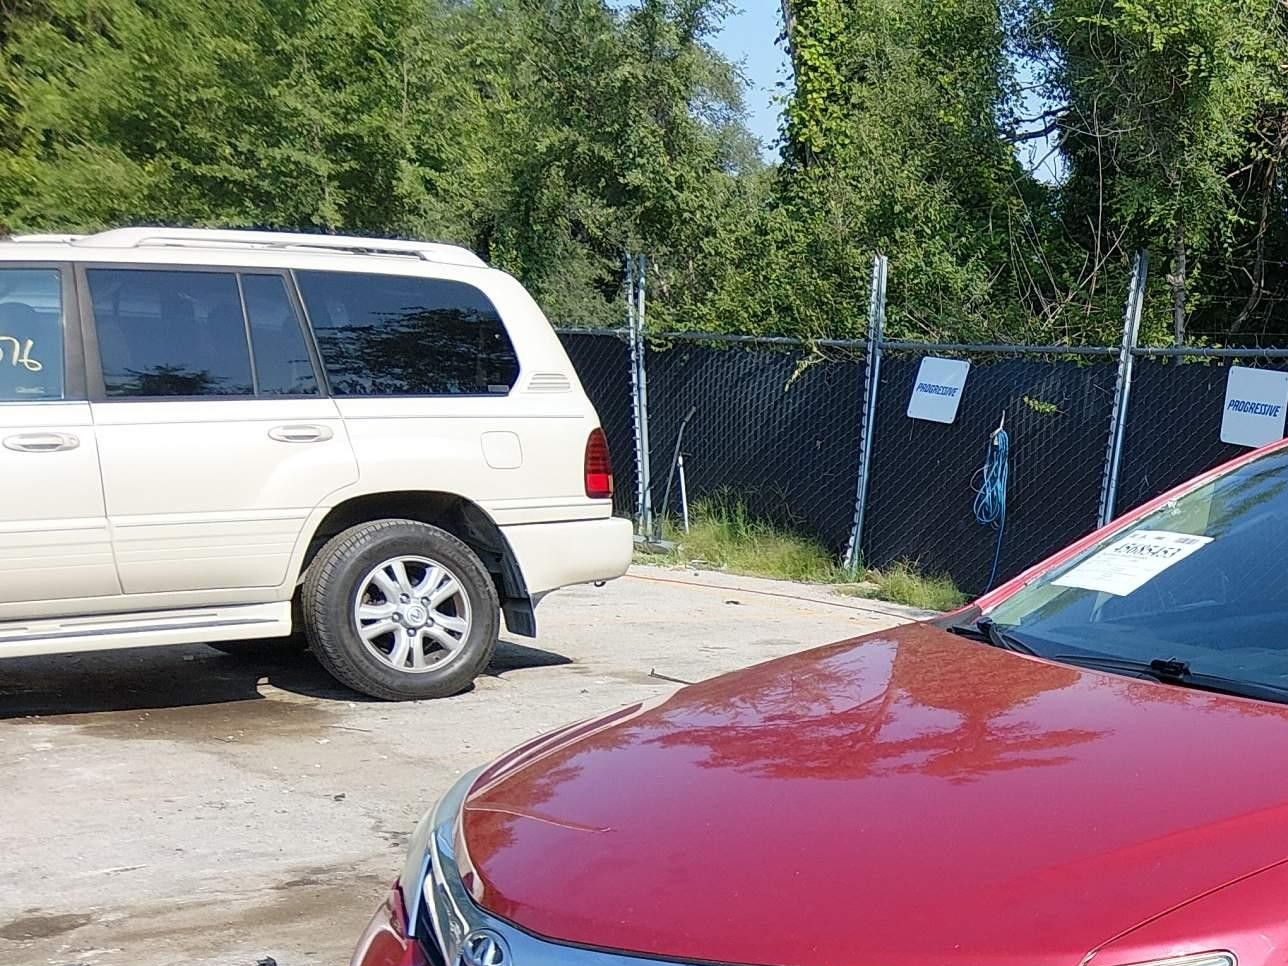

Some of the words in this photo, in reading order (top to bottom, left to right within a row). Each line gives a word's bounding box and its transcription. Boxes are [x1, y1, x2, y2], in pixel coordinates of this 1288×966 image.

[0, 336, 43, 372] 76
[916, 382, 959, 397] PROGRESSIVE
[1227, 399, 1281, 417] PROGRESSIVE
